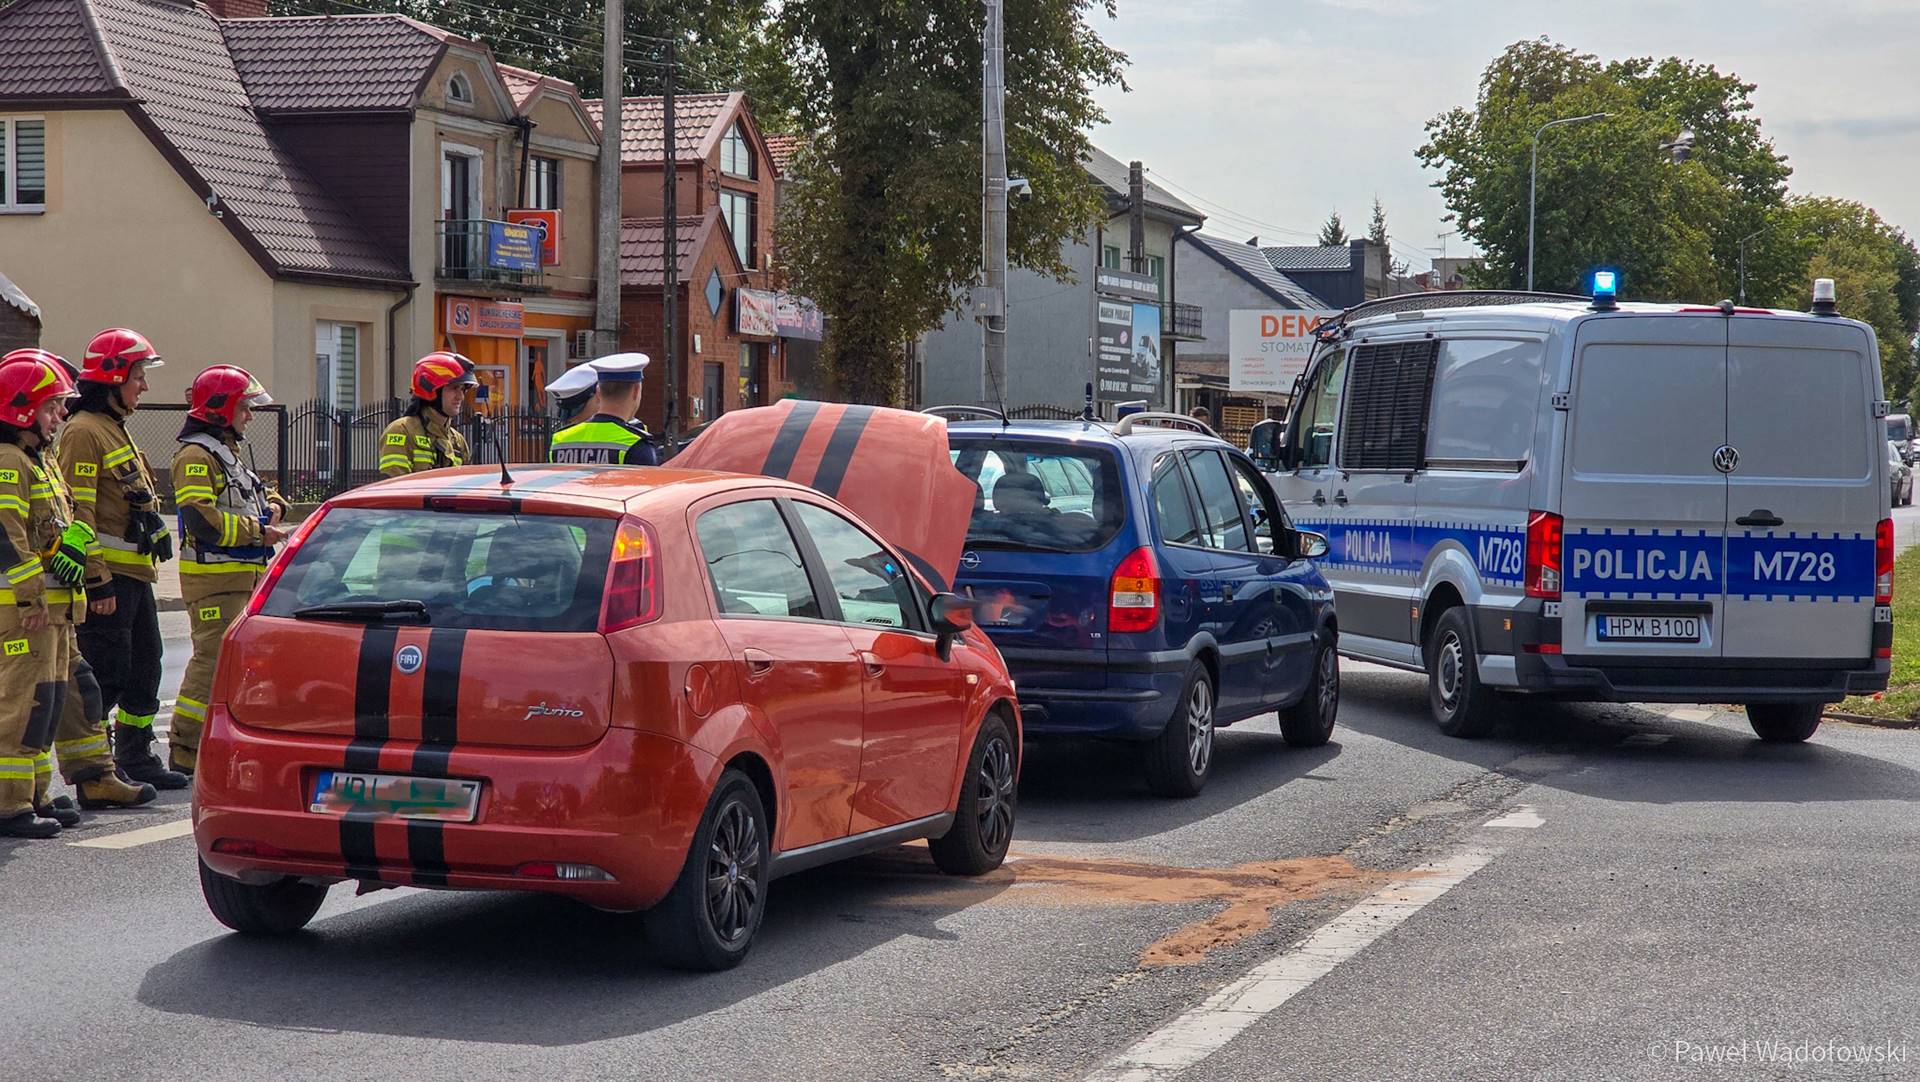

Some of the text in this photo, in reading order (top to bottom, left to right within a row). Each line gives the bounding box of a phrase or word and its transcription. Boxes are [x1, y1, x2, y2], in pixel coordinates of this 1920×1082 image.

[1261, 315, 1330, 337] DEM
[1261, 342, 1319, 352] STOMAT
[78, 465, 95, 474] PSP
[188, 465, 205, 473] PSP
[1345, 530, 1392, 564] POLICJA
[1479, 536, 1522, 575] M728
[1573, 549, 1713, 581] POLICJA
[1754, 551, 1836, 582] M728
[202, 609, 217, 619] PSP
[1610, 618, 1694, 637] HPM B100
[7, 642, 25, 653] PSP
[400, 654, 418, 665] FIAT
